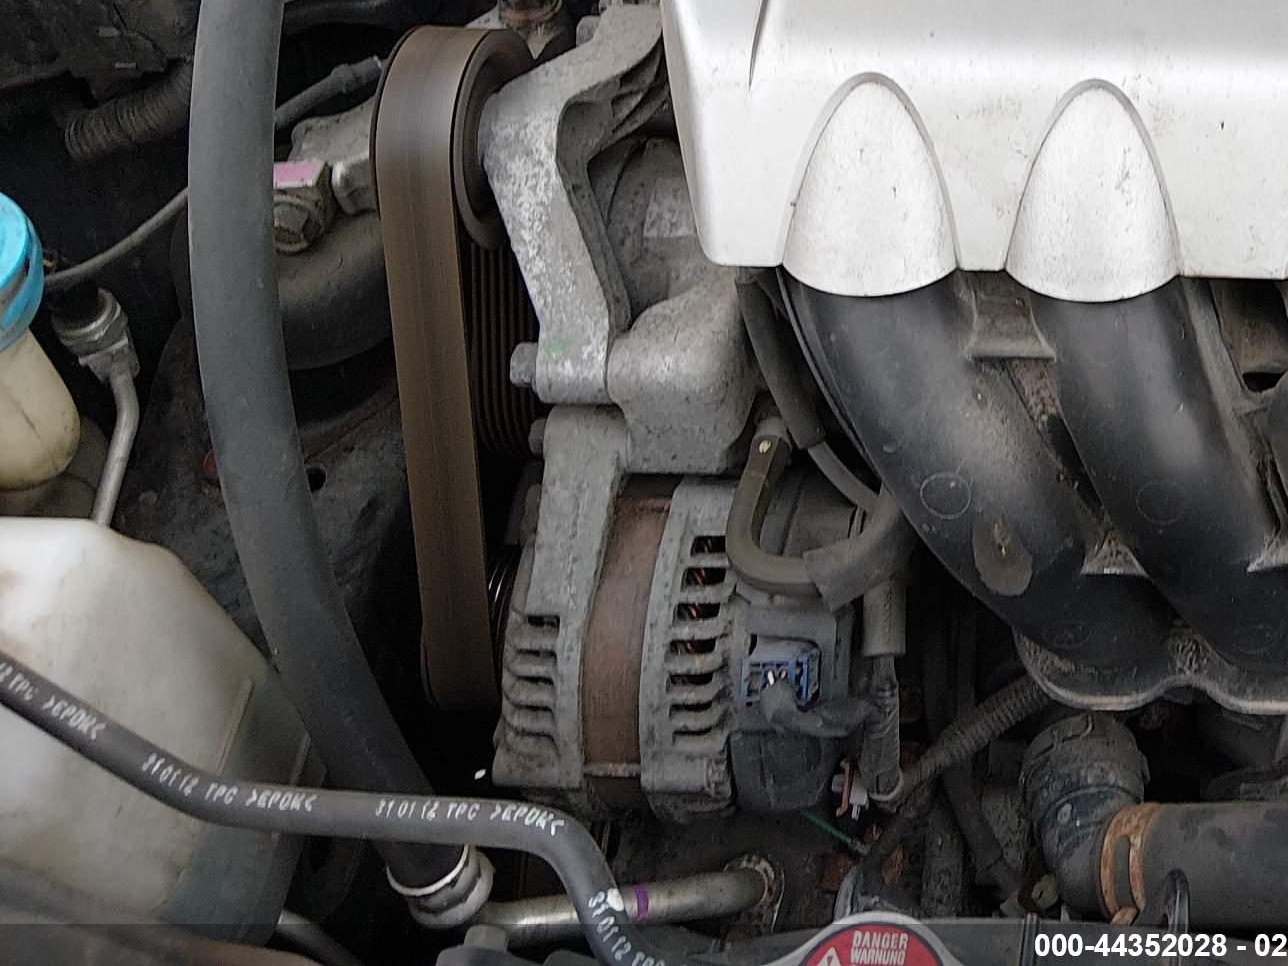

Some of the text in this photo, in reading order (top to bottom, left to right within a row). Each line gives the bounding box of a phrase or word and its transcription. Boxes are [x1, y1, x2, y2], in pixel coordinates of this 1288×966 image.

[204, 783, 239, 805] TPC
[446, 800, 480, 822] TPC
[852, 930, 908, 951] DANGER
[850, 947, 906, 965] WARNUNG
